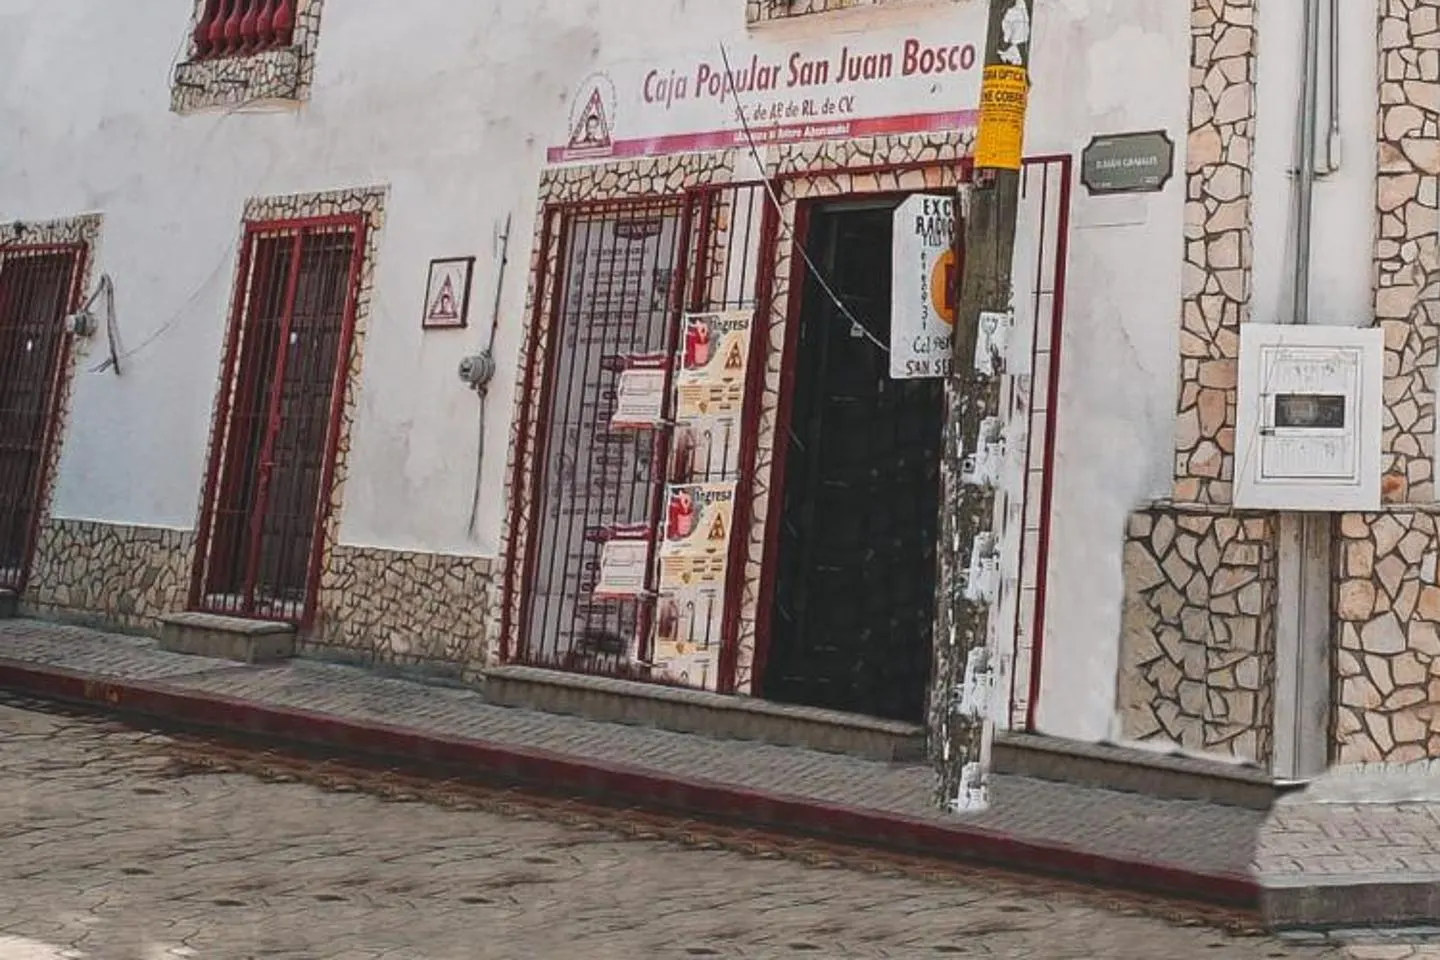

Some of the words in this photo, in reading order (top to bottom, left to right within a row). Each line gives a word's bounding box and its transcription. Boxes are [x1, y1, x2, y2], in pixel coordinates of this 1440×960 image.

[643, 68, 688, 110] Caja
[695, 53, 781, 104] Popular
[786, 51, 830, 88] San
[836, 45, 893, 84] Juan
[902, 38, 975, 77] Bosco
